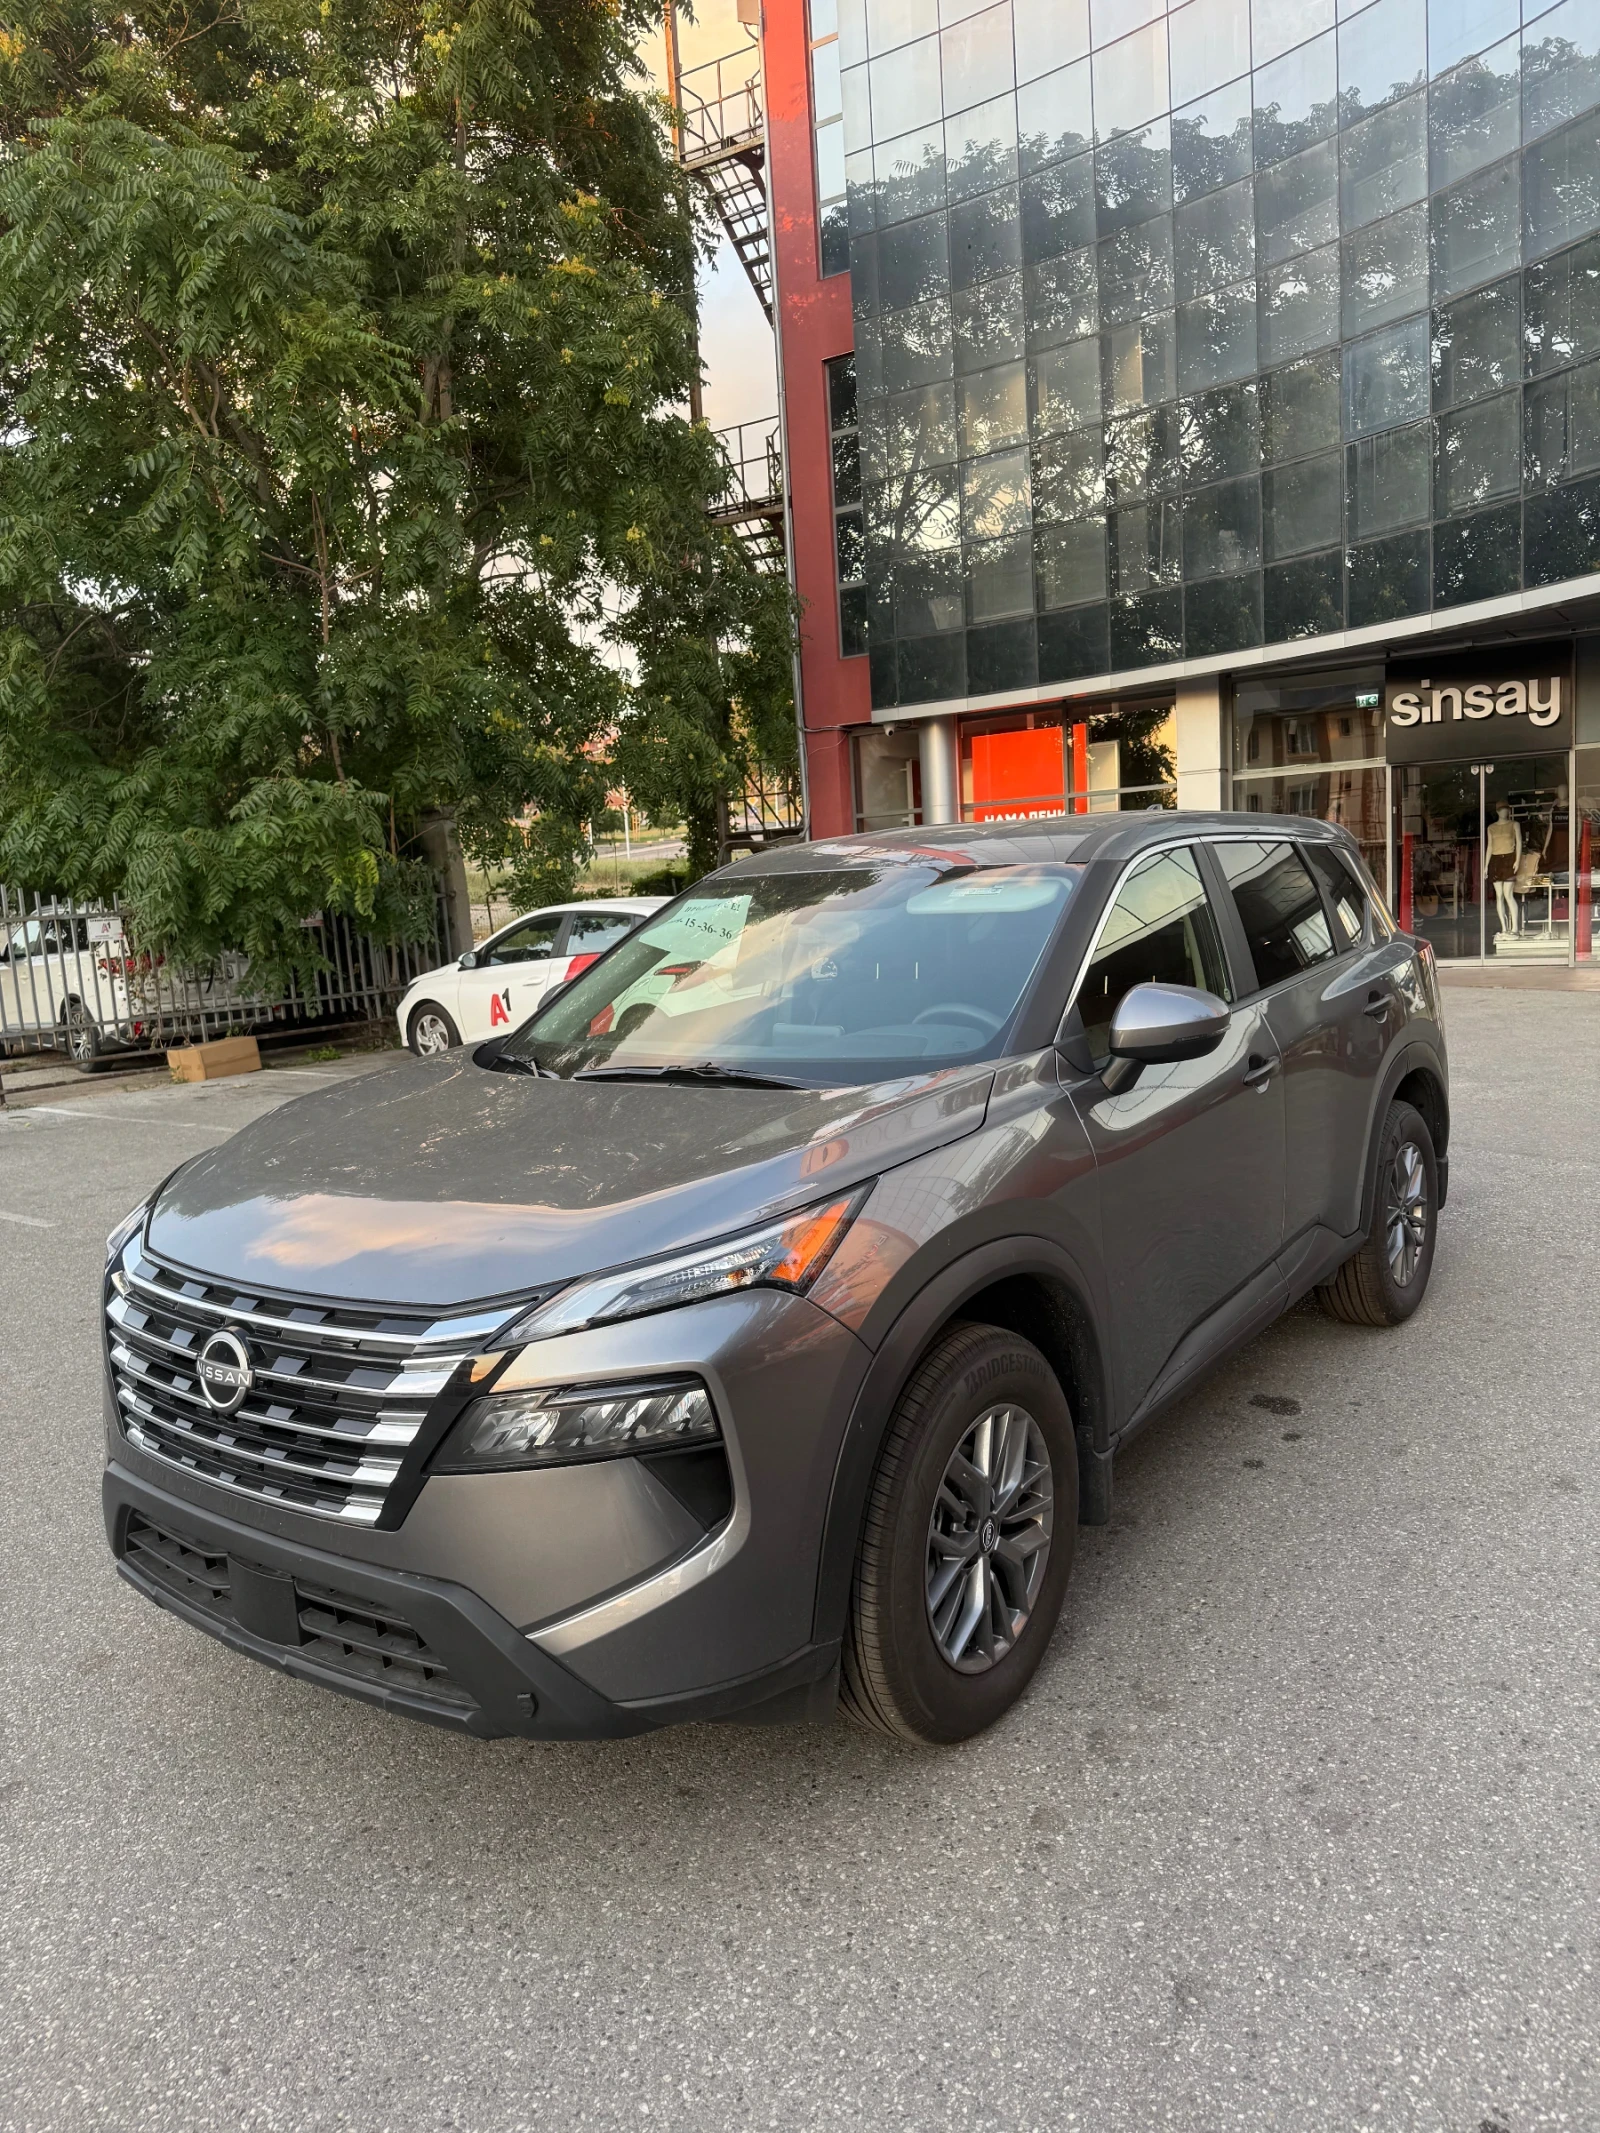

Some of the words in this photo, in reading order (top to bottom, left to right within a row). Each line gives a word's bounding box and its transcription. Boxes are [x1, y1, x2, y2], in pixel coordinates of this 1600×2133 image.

[1390, 676, 1561, 727] sinsay
[984, 808, 1077, 823] НАМАЛЕНИ
[490, 986, 512, 1027] A1
[196, 1359, 250, 1386] NISSAN
